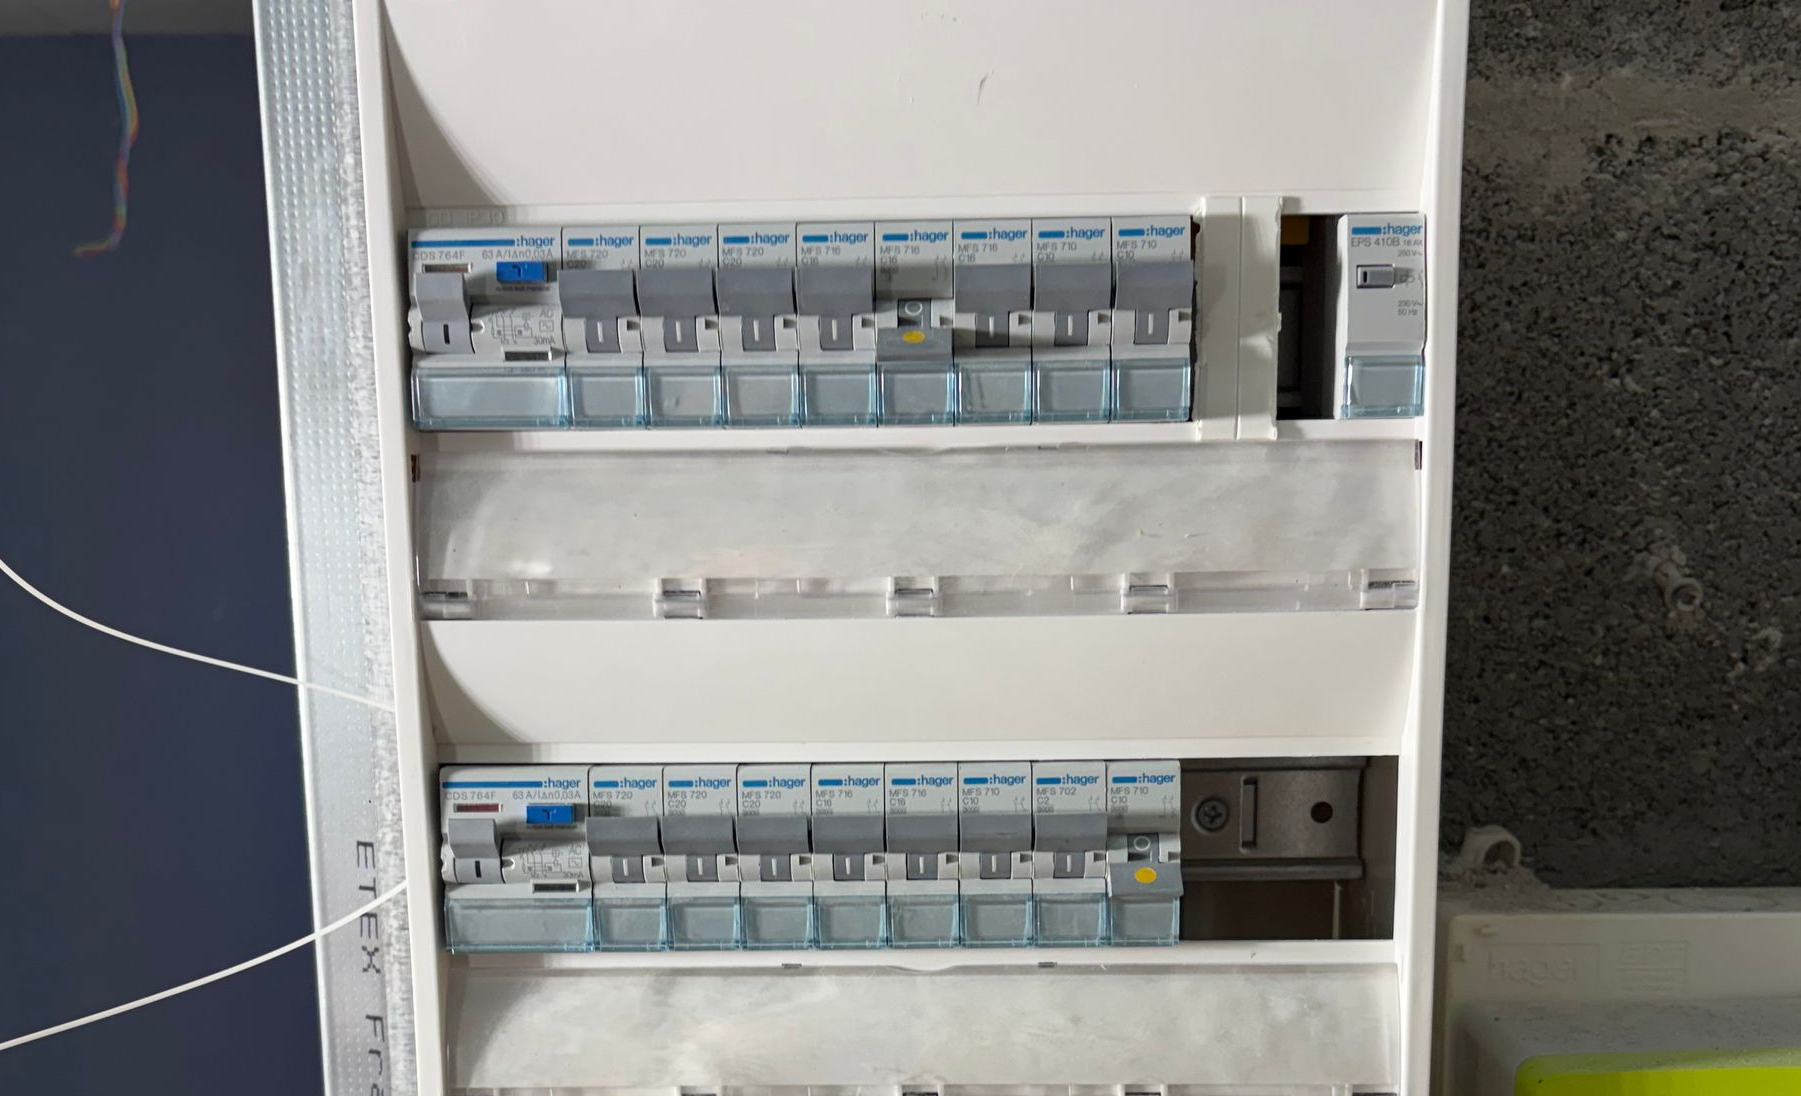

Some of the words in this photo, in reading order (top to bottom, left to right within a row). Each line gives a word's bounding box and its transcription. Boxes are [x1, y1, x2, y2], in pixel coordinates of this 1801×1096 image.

[1351, 237, 1372, 247] EPS
[1373, 236, 1400, 247] 410B
[412, 250, 435, 260] CDS
[445, 791, 468, 801] CDS
[470, 791, 496, 800] 764F
[513, 790, 524, 800] 63
[592, 791, 614, 800] MFS
[615, 790, 633, 800] 720
[667, 791, 688, 800] MFS
[690, 790, 707, 800] 720
[742, 791, 763, 800] MFS
[764, 790, 782, 800] 720
[815, 790, 836, 799] MFS
[838, 789, 853, 798] 716
[889, 788, 909, 798] MFS
[911, 788, 927, 797] 716
[962, 787, 983, 797] MFS
[985, 787, 1000, 796] 710
[1036, 787, 1058, 796] MFS
[1059, 787, 1077, 796] 702
[1110, 786, 1131, 796] MFS
[1133, 786, 1149, 795] 710
[356, 840, 382, 974] ETEX
